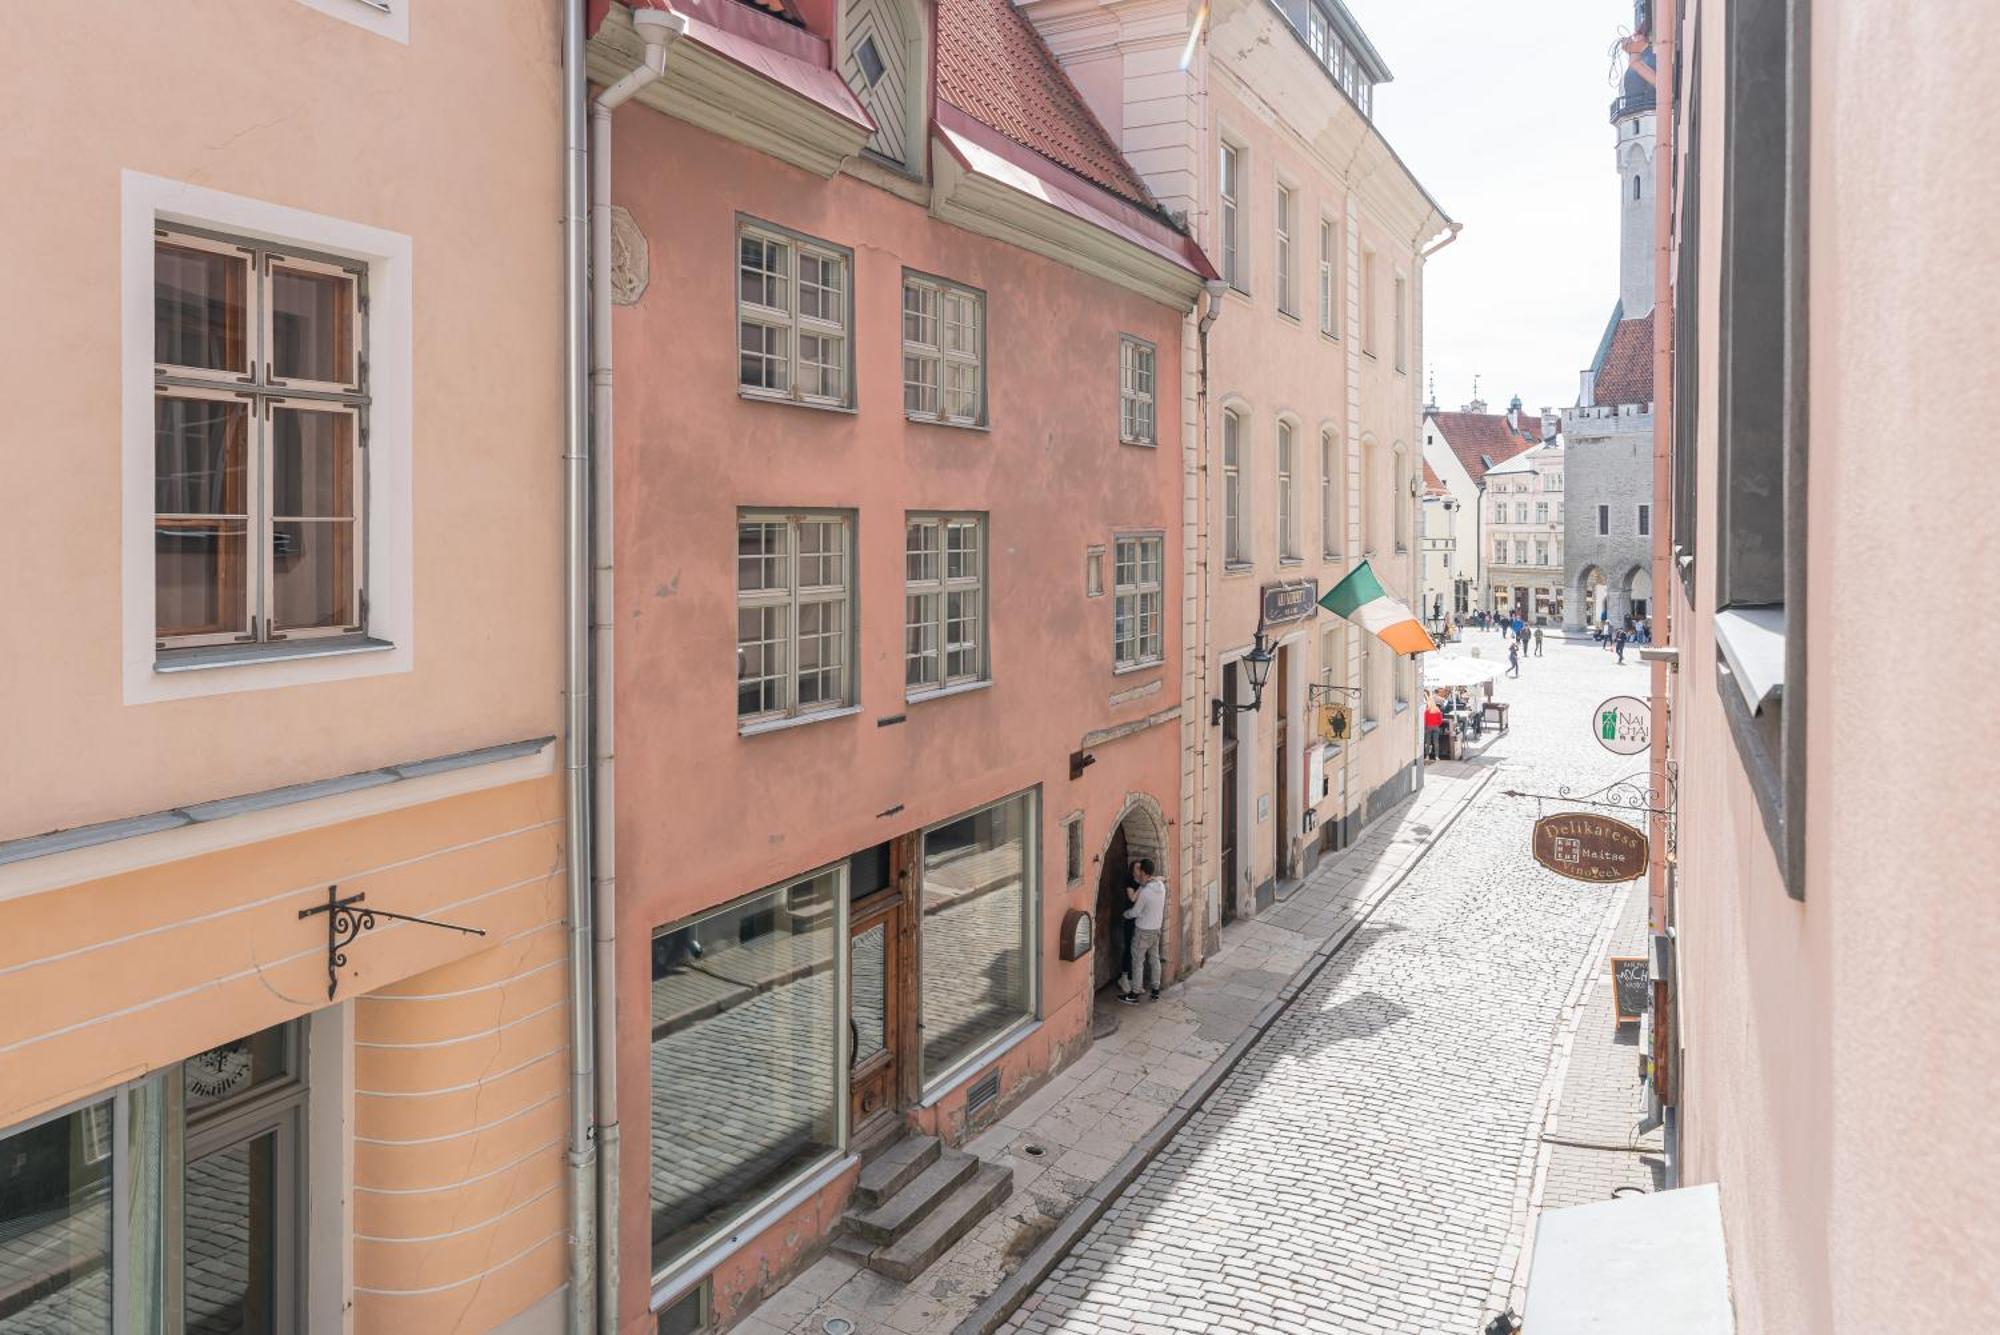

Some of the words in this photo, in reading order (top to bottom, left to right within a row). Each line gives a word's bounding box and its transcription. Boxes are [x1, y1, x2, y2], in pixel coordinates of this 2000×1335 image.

[1619, 712, 1644, 726] NAI
[1618, 723, 1649, 737] CHAI
[191, 1064, 250, 1097] Distillery
